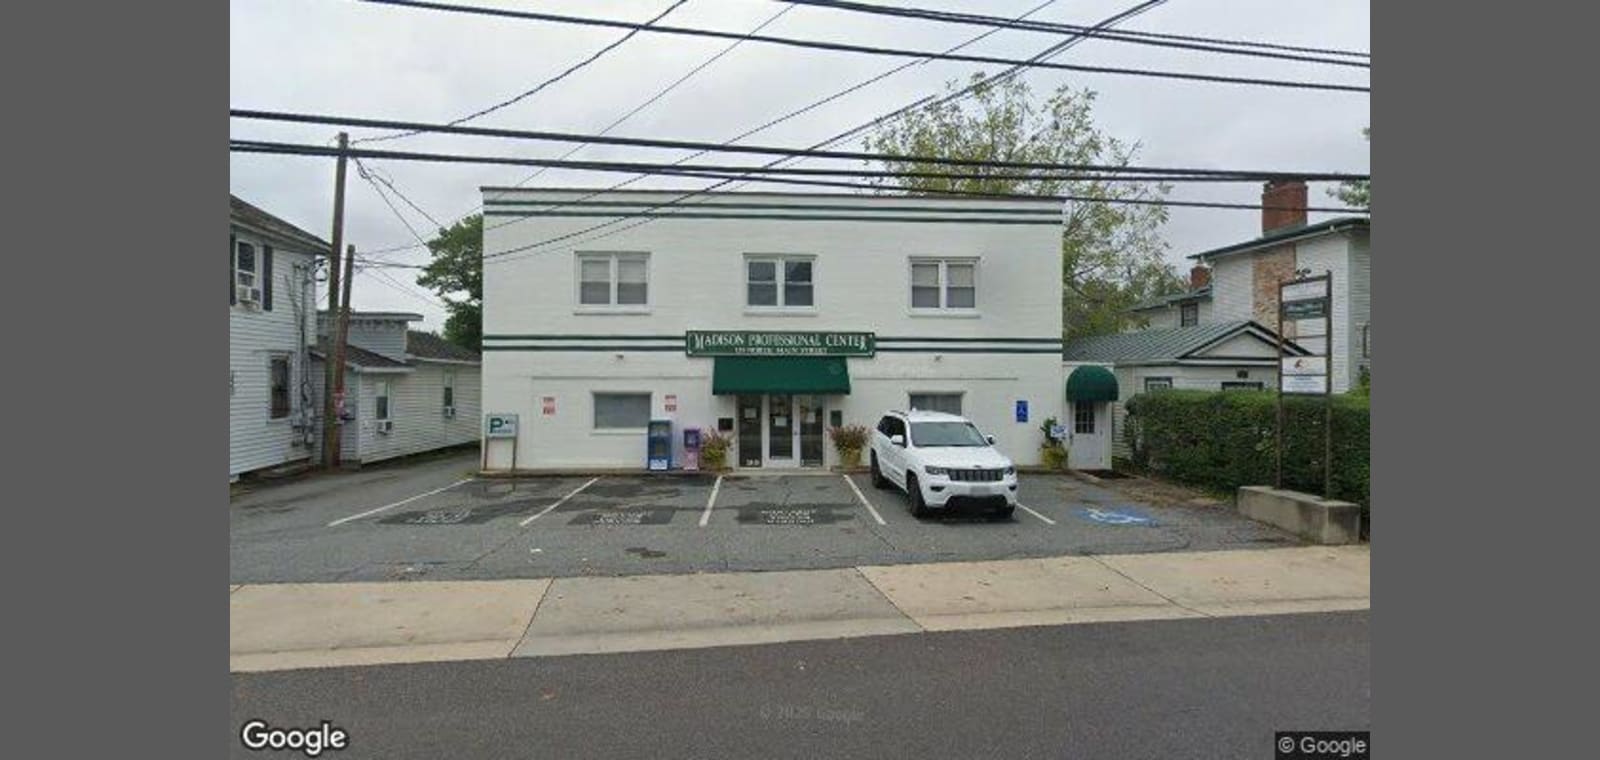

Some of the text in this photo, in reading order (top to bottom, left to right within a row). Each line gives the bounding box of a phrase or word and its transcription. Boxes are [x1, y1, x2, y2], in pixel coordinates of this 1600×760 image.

[688, 333, 868, 350] MADISON PROFESSIONAL CENTER
